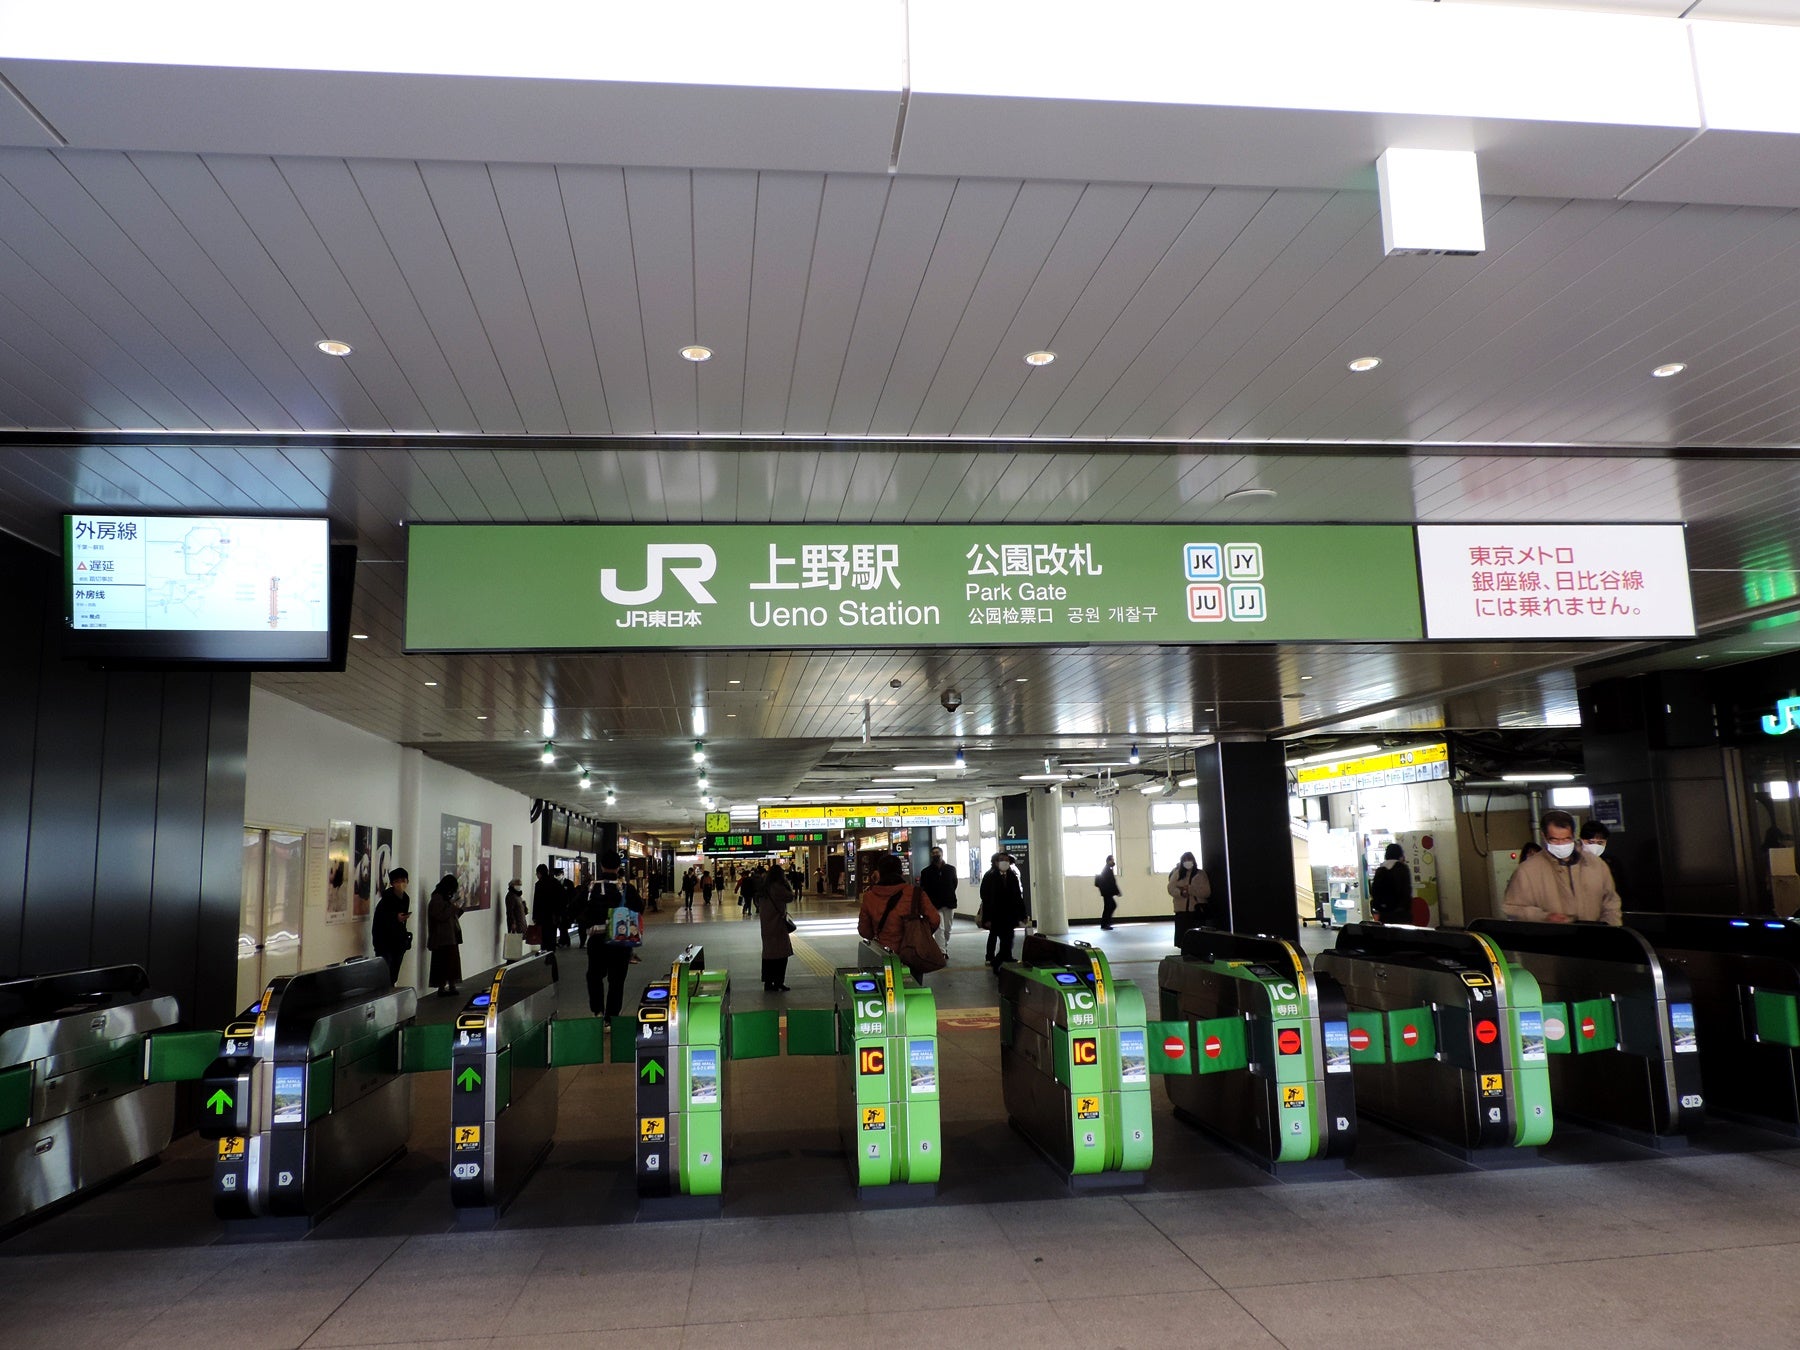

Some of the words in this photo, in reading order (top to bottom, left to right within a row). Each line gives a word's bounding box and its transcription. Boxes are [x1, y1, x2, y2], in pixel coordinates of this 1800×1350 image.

[75, 521, 138, 540] 外房線
[965, 542, 1103, 577] 公園改札
[1193, 554, 1214, 570] JK
[1234, 554, 1254, 569] JY
[1469, 545, 1574, 566] 東京メトロ
[89, 560, 115, 571] 遅延
[600, 543, 717, 606] JR
[749, 543, 902, 591] 上野駅
[1472, 571, 1645, 592] 銀座線、日比谷線
[966, 582, 1013, 601] Park
[1018, 582, 1067, 601] Gate
[1195, 595, 1217, 611] JU
[1238, 594, 1256, 610] JJ
[1476, 597, 1644, 618] には乗れません。
[615, 609, 702, 628] JR東日本
[749, 601, 828, 628] Ueno
[838, 599, 941, 627] Station
[968, 606, 1053, 625] 公园检票口
[1067, 606, 1100, 623] 공원
[1108, 606, 1158, 623] 개찰구
[1007, 826, 1016, 838] 4
[896, 843, 902, 851] 6
[1268, 983, 1297, 1000] IC
[857, 1000, 883, 1018] IC
[1067, 992, 1094, 1010] IC
[1277, 1004, 1298, 1016] 専用
[860, 1022, 882, 1034] 専用
[1073, 1013, 1094, 1025] 専用
[862, 1051, 883, 1072] IC
[1074, 1042, 1096, 1063] IC
[226, 1176, 234, 1185] 10
